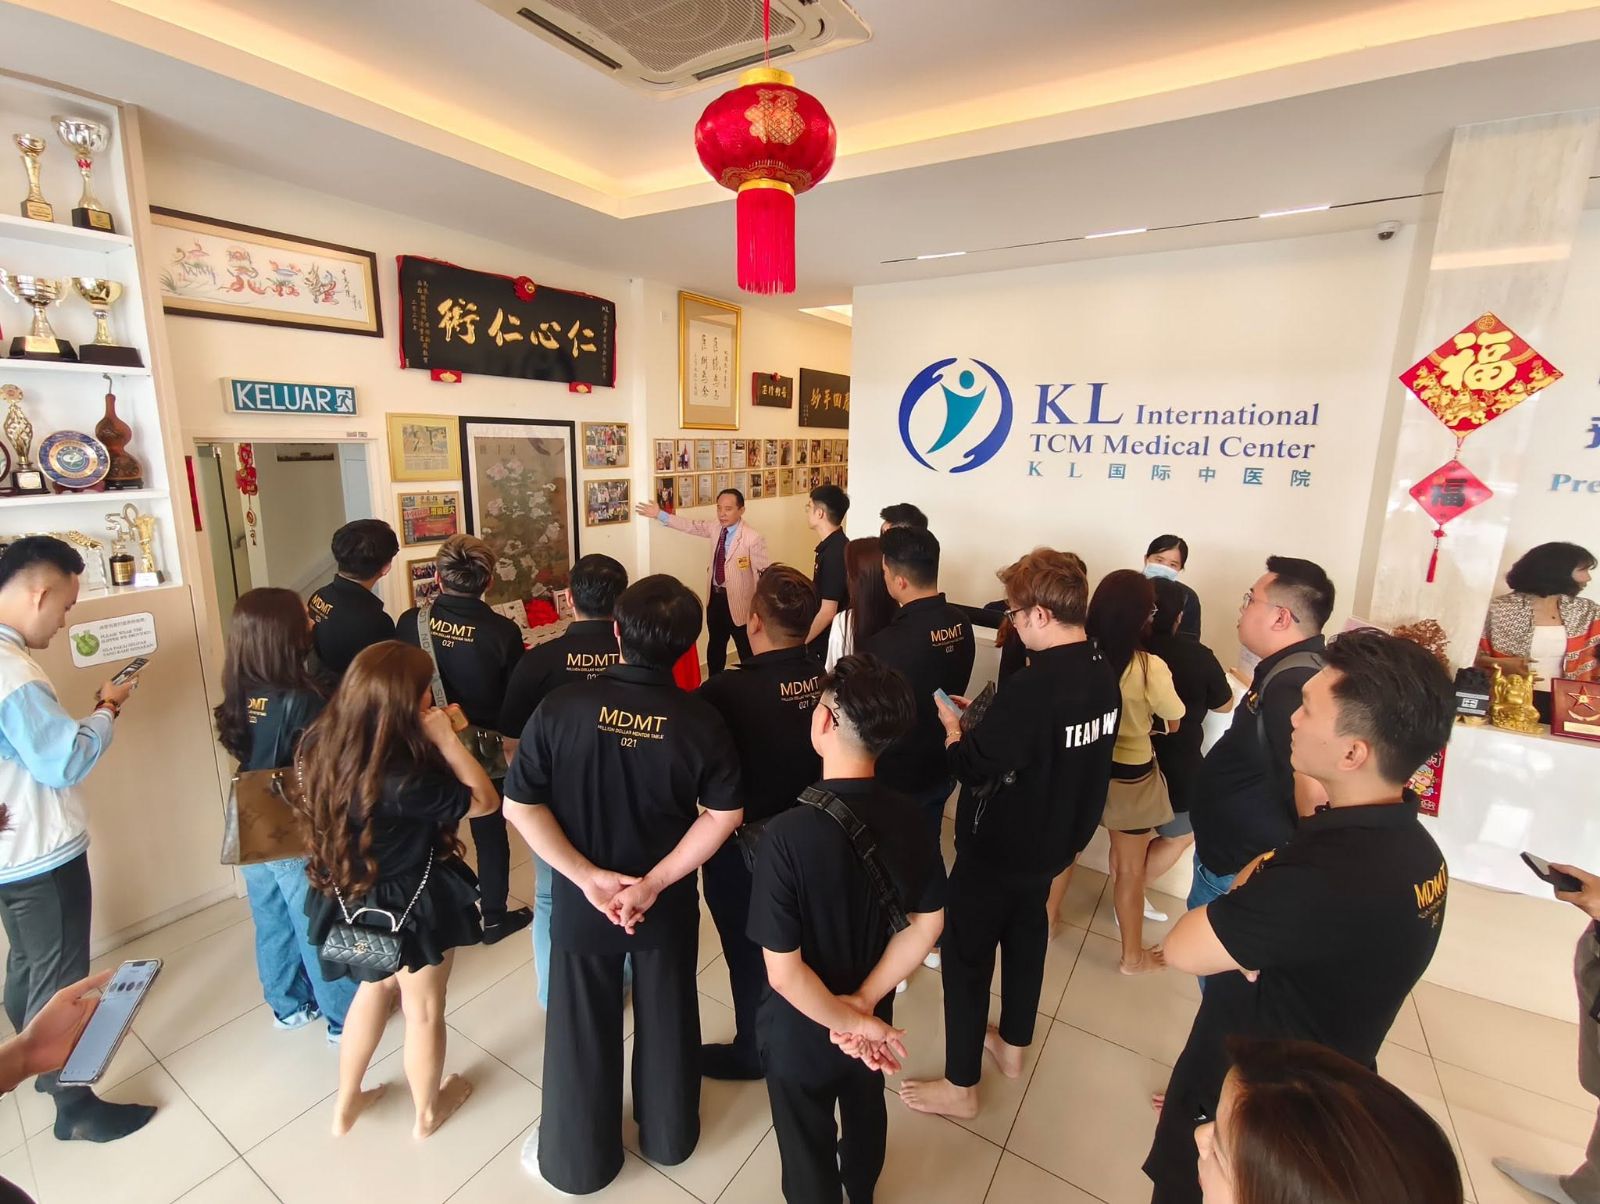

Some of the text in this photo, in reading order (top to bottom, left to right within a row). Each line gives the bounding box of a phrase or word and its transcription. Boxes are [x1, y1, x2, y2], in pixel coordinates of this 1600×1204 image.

[1439, 330, 1518, 391] 福
[236, 383, 332, 412] KELUAR
[1031, 382, 1320, 426] KL International
[1029, 433, 1316, 459] TCM Medical Center
[1431, 478, 1468, 507] 福
[311, 594, 334, 615] MDMT
[429, 617, 476, 638] MDMT
[930, 623, 963, 642] MDMT
[441, 639, 455, 648] 021
[567, 653, 619, 667] MDMT
[780, 676, 819, 696] MDMT
[247, 698, 269, 711] DMT
[599, 706, 668, 733] MDMT
[597, 724, 615, 732] MILLION
[632, 731, 650, 739] MENTOR
[1065, 717, 1100, 749] TEAM
[620, 737, 638, 748] 021
[1413, 861, 1447, 909] MDMT
